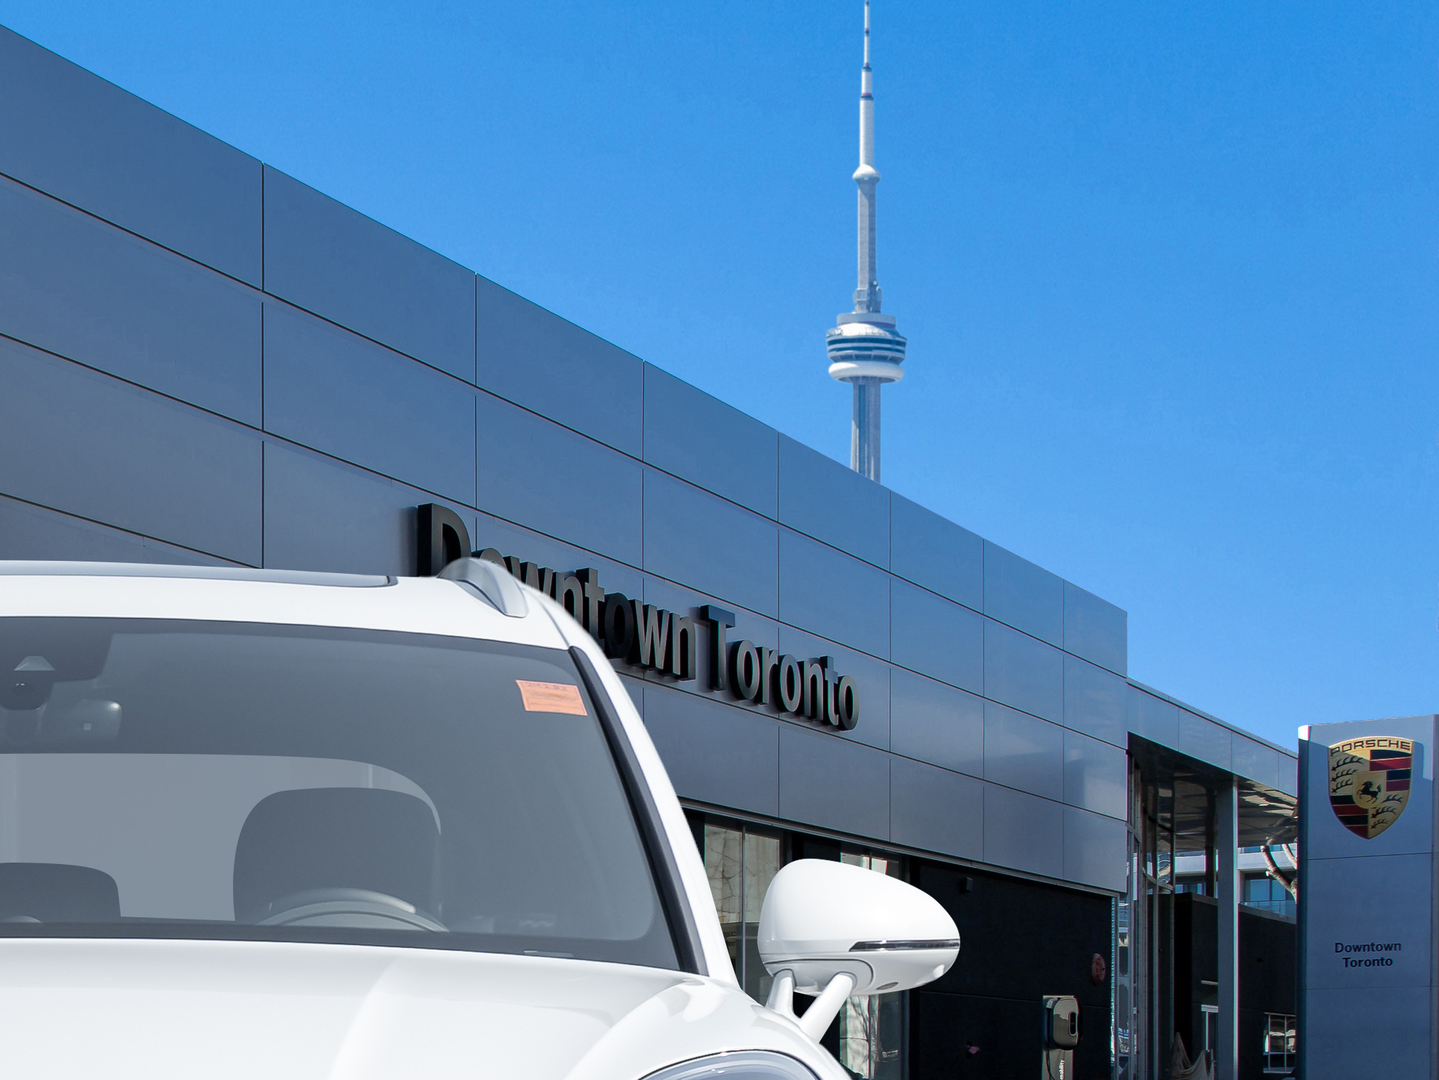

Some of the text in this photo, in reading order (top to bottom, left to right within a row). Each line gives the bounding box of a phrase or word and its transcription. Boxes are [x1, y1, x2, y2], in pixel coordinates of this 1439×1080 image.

[418, 503, 860, 731] Dntown Toronto
[1330, 739, 1411, 757] PORSCHE
[1334, 942, 1401, 953] Downtown
[1342, 957, 1393, 968] Toronto
